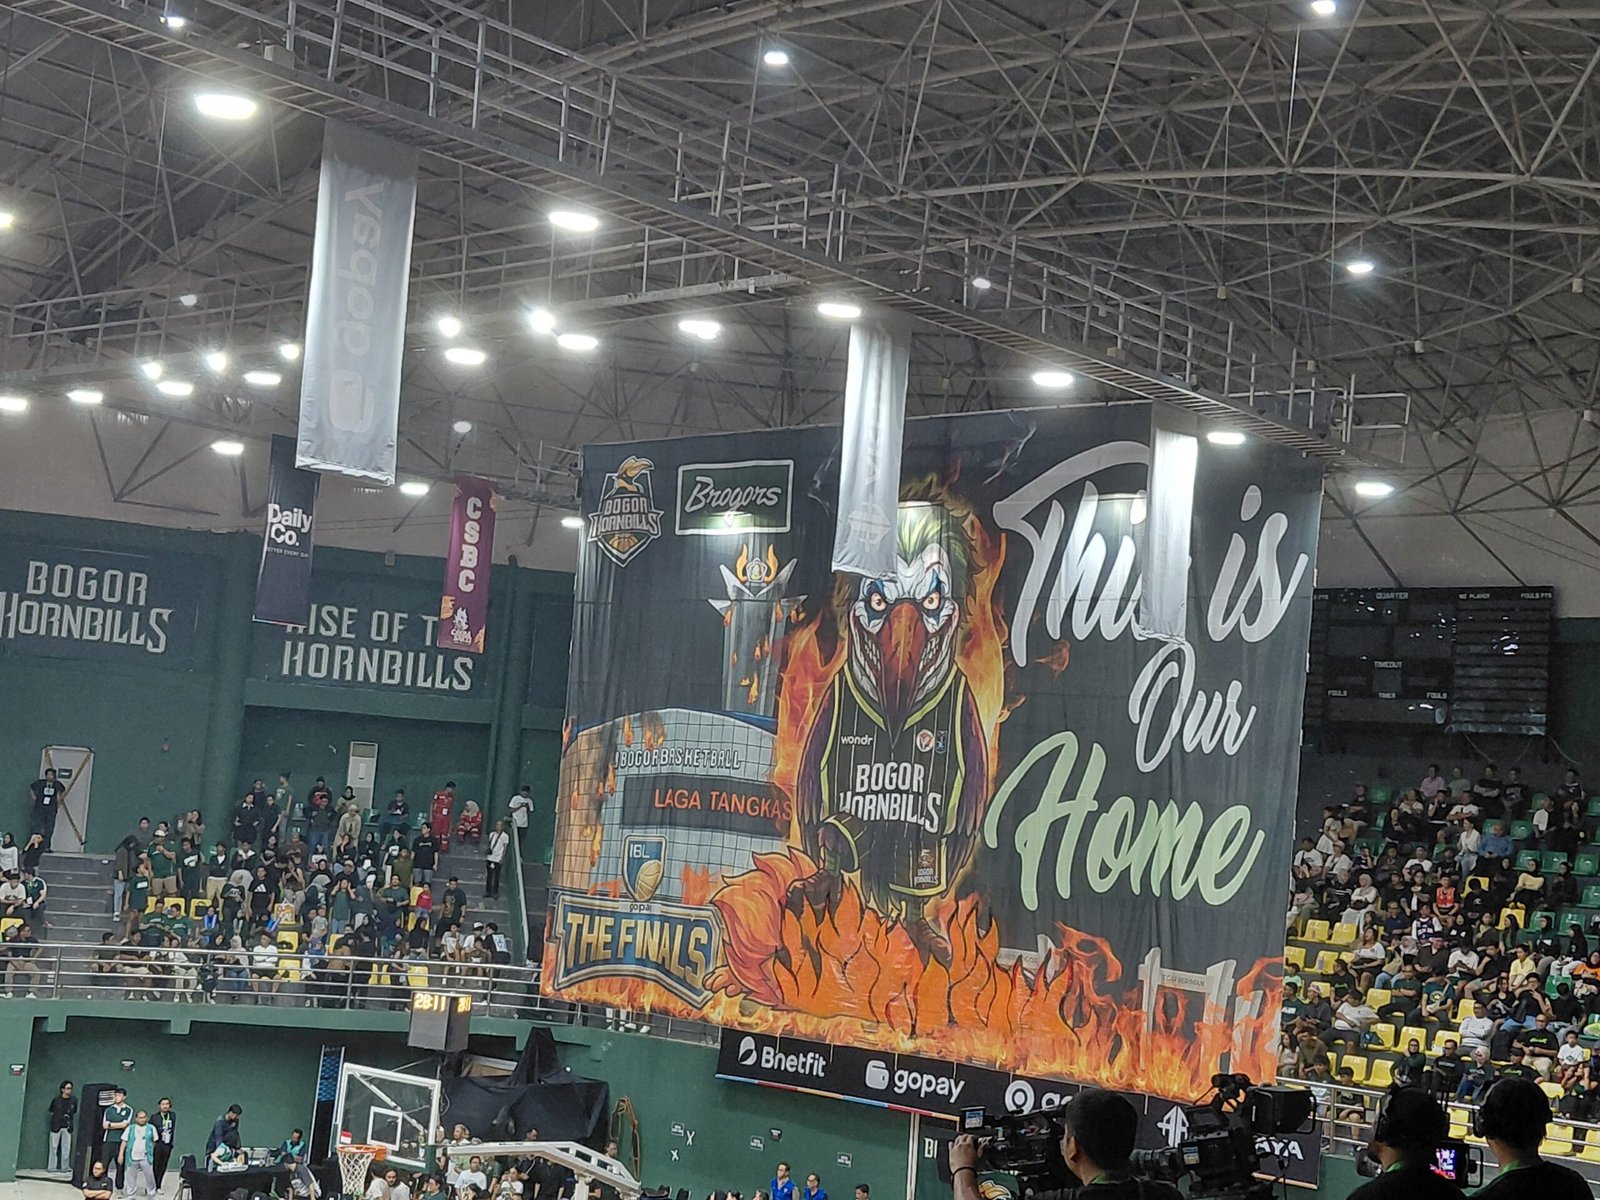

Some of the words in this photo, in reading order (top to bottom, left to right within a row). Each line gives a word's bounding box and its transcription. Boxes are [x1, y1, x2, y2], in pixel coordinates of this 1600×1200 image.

[603, 497, 649, 516] BOGOR
[684, 475, 782, 513] Brogors
[267, 503, 312, 533] Daily
[592, 511, 659, 537] HORNBILLS
[270, 523, 300, 547] Co.
[458, 496, 482, 592] CSBC
[993, 441, 1191, 667] Thi
[1207, 485, 1309, 643] is
[26, 560, 148, 606] BOGOR
[1375, 592, 1409, 600] QUARTER
[0, 591, 176, 653] HORNBILLS
[287, 603, 358, 639] ISE
[370, 610, 408, 643] OF
[281, 640, 474, 691] HORNBILLS
[1374, 660, 1403, 668] TIMEOUT
[1128, 640, 1257, 773] Our
[841, 734, 873, 746] wondr
[856, 761, 925, 793] BOGOR
[654, 788, 701, 810] LAGA
[710, 790, 792, 820] TANGKAS
[984, 731, 1265, 912] Home
[630, 844, 651, 858] IBL
[566, 911, 614, 969] THE
[617, 918, 708, 991] FINALS
[414, 993, 447, 1012] 28:11
[761, 1045, 827, 1078] Bnetfit
[893, 1068, 965, 1103] gopay
